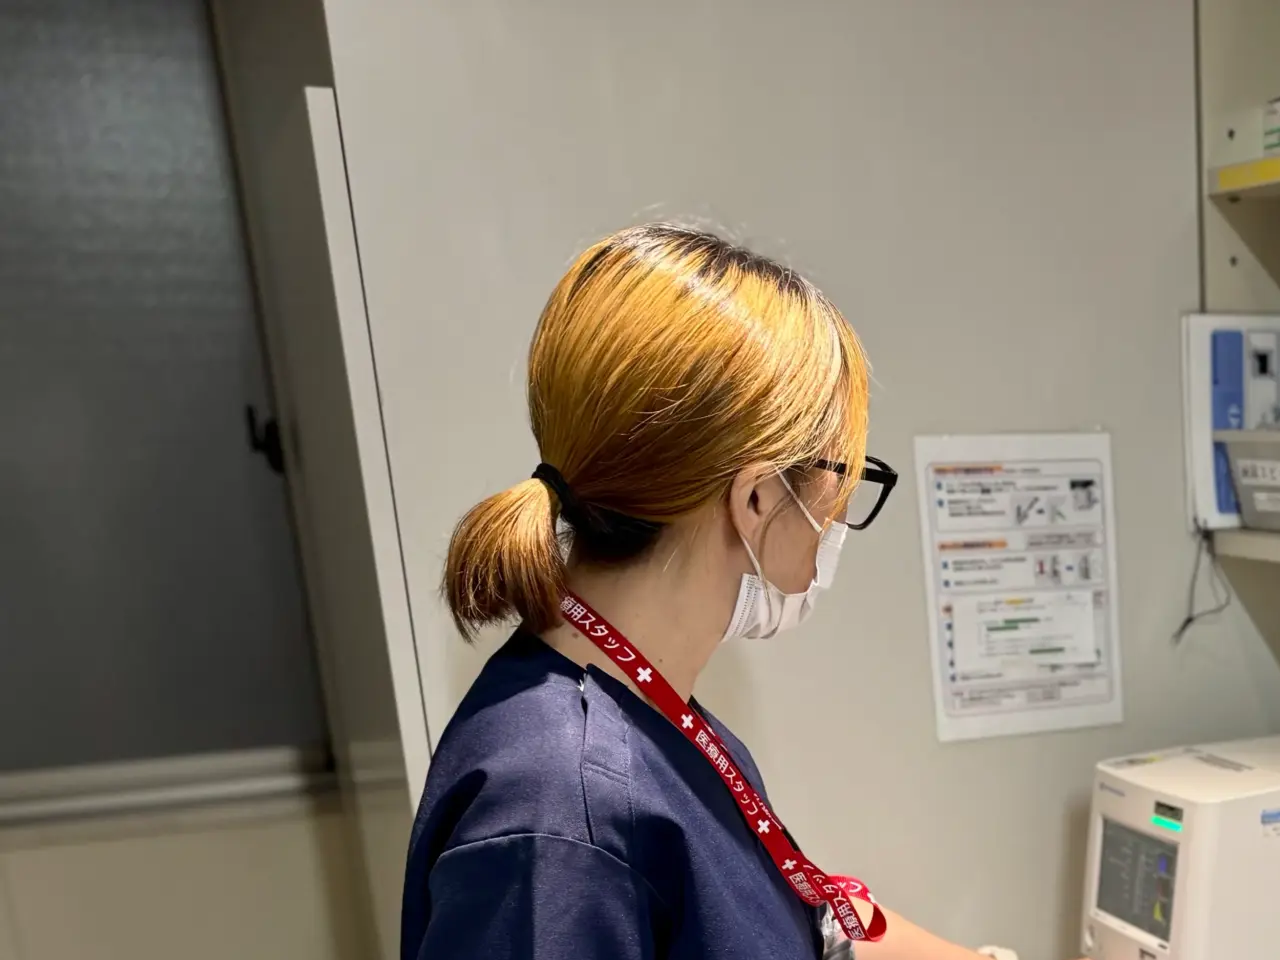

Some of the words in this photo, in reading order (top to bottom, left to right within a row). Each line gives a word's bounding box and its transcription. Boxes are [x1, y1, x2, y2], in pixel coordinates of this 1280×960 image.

[695, 729, 758, 815] 医療用スタッフ
